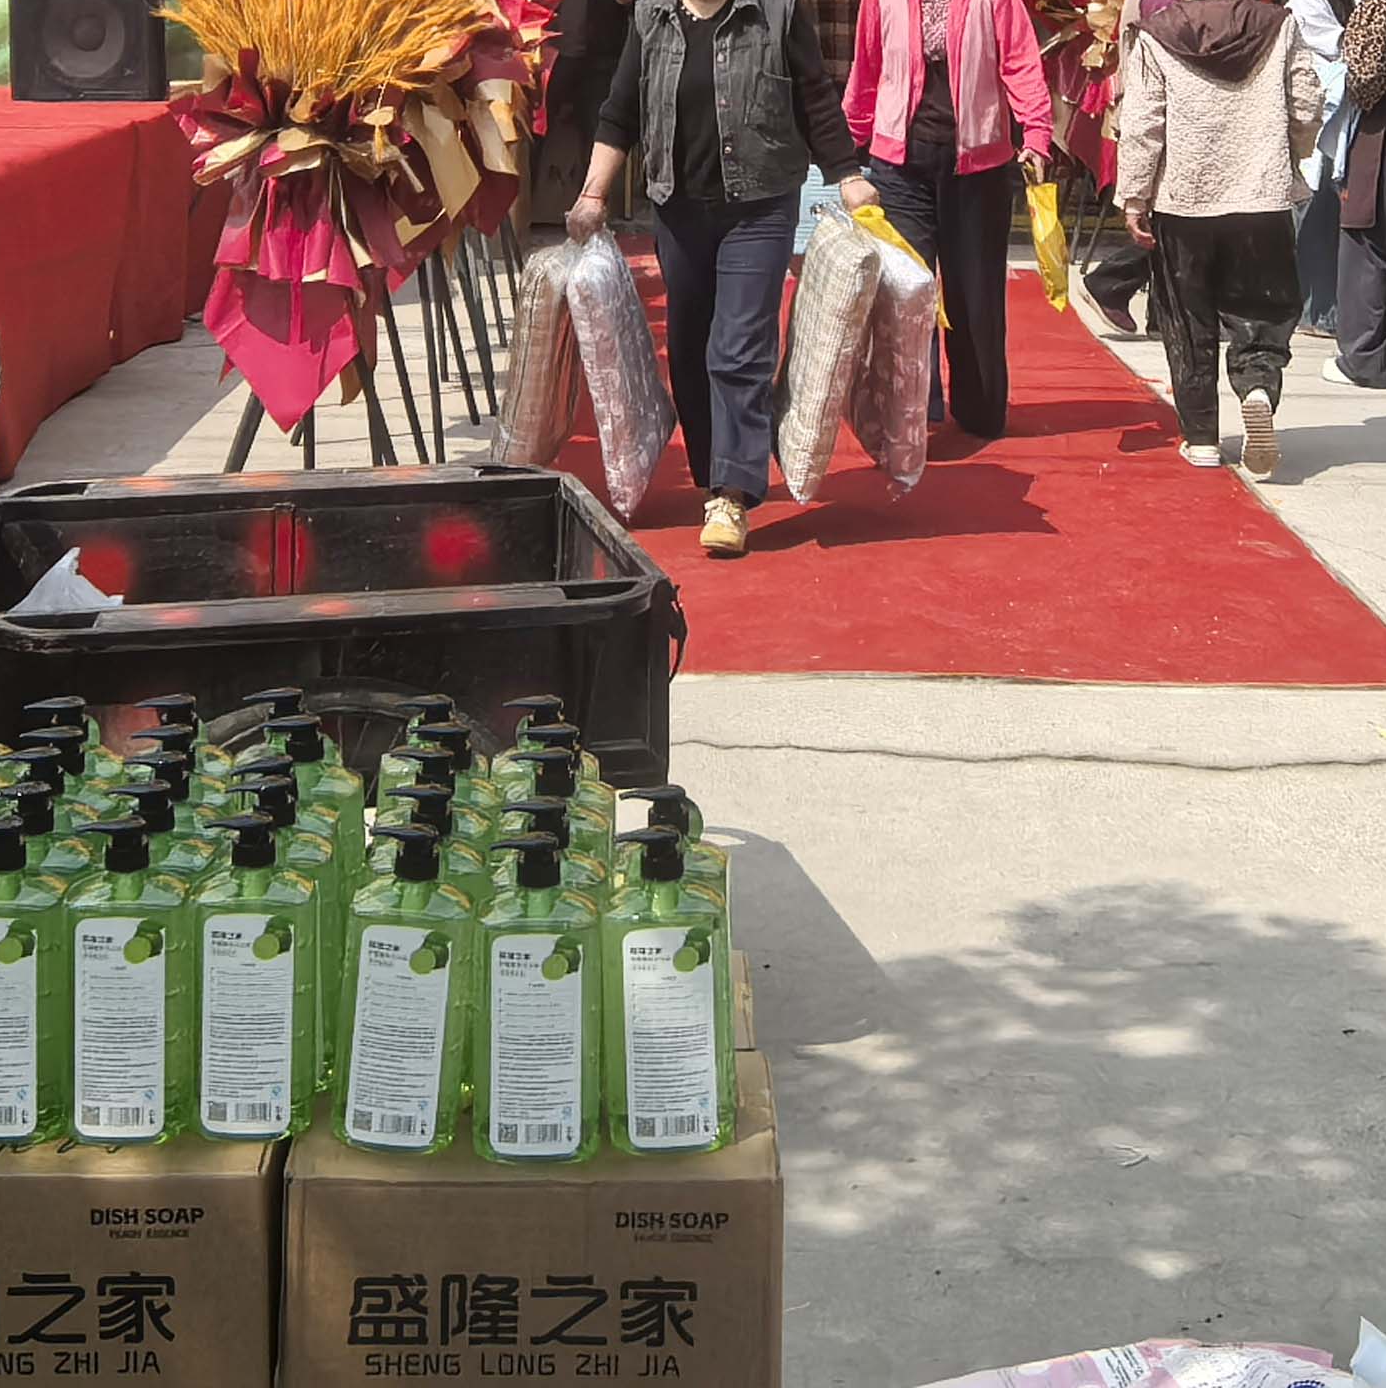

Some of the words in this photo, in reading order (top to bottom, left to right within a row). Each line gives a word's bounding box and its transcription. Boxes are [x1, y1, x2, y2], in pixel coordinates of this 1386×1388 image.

[89, 1208, 140, 1226] DISH
[144, 1207, 206, 1225] SOAP
[614, 1212, 665, 1229] DISH
[668, 1212, 730, 1230] SOAP
[346, 1273, 700, 1349] 盛隆之家
[53, 1351, 101, 1380] ZHI
[116, 1351, 162, 1380] JIA
[364, 1353, 463, 1378] SHENG
[479, 1353, 557, 1378] LONG
[574, 1353, 621, 1378] ZHI
[637, 1353, 682, 1378] JIA
